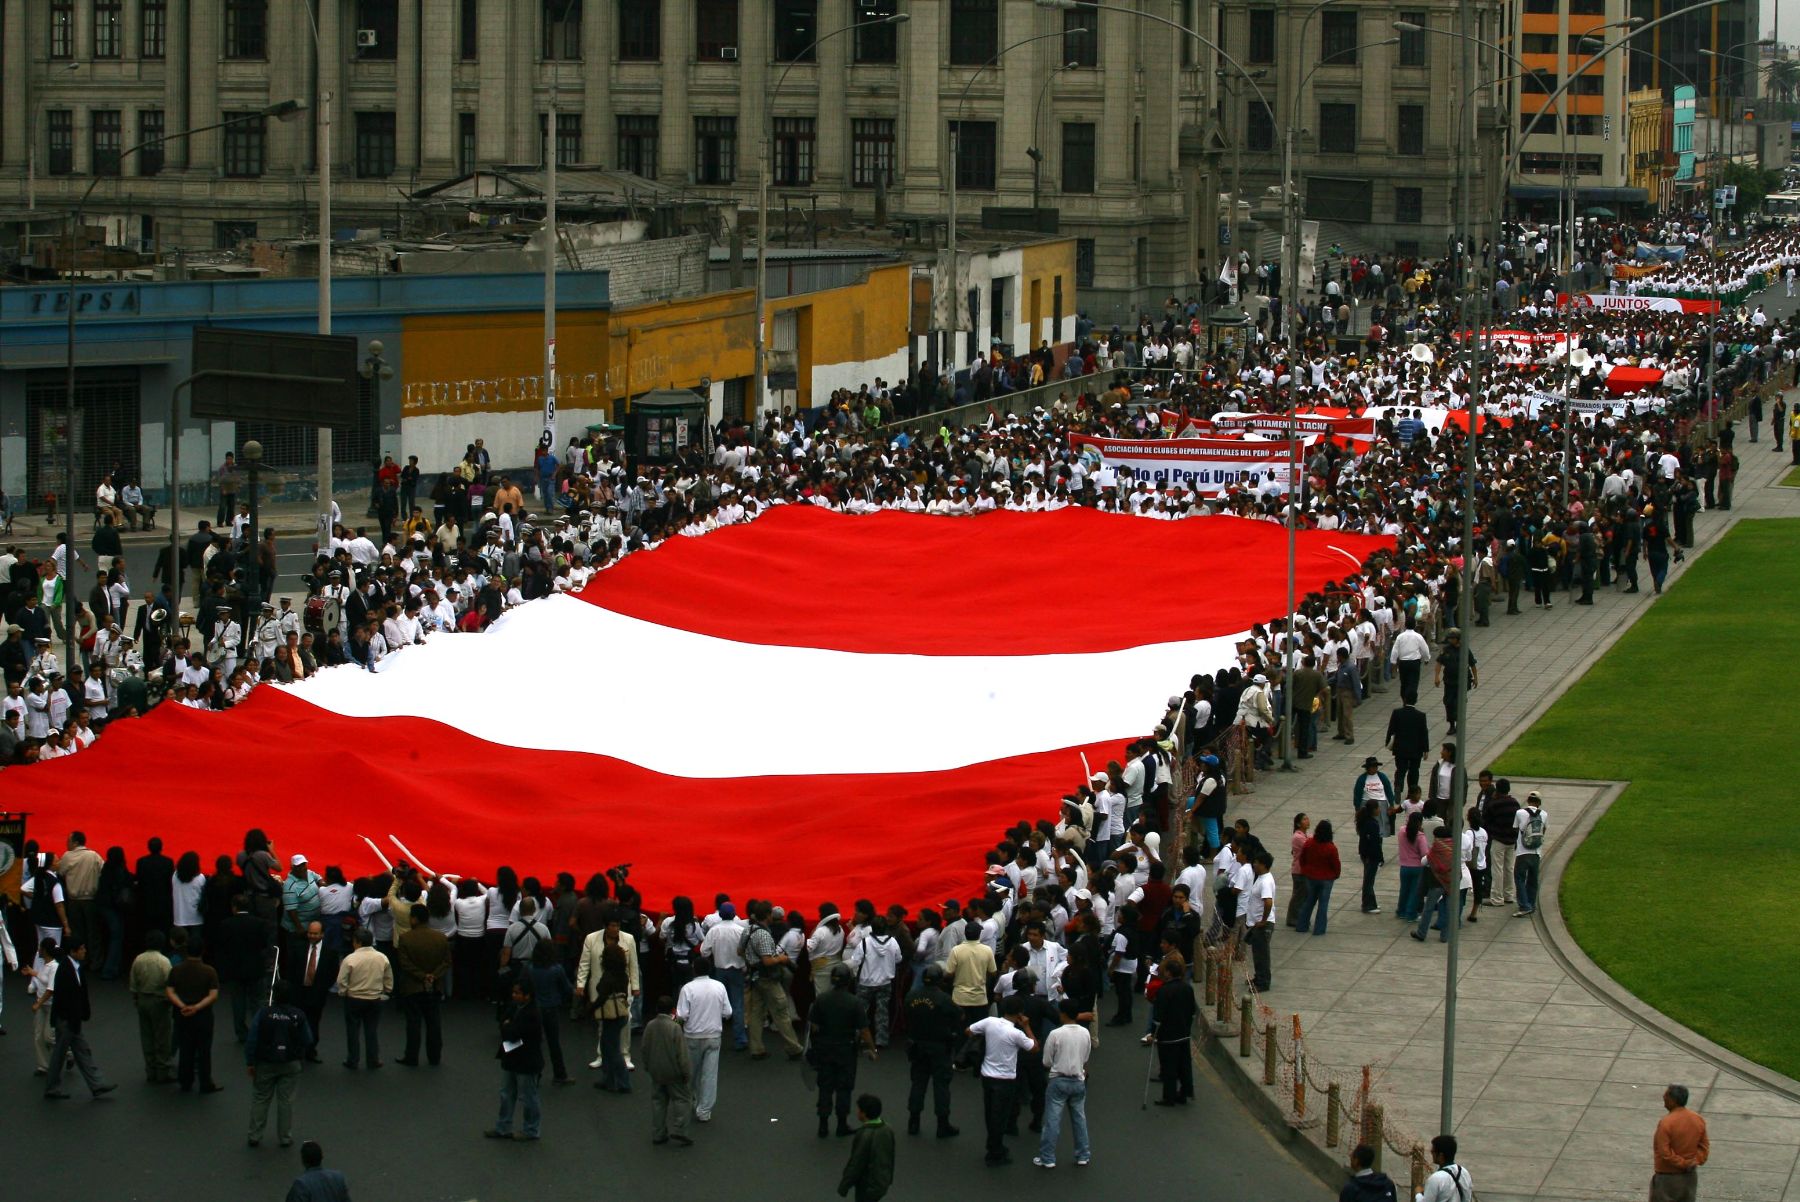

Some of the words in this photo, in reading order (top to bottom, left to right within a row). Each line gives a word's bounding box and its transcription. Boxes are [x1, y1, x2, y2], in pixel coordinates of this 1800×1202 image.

[31, 291, 136, 313] TEPSA
[1602, 298, 1650, 310] JUNTOS
[548, 401, 554, 420] 9
[1215, 420, 1236, 428] CLUB
[1302, 422, 1327, 431] TACNA
[542, 429, 553, 448] 9
[1103, 444, 1144, 454] ASOCIACIÓN
[1144, 446, 1153, 454] DE
[1153, 446, 1178, 455] CLUBES
[1178, 447, 1240, 457] DEPARTAMENTALES
[1240, 449, 1252, 457] DEL
[1252, 448, 1270, 457] PERÚ
[1158, 468, 1168, 483] el
[1172, 467, 1210, 484] Perú
